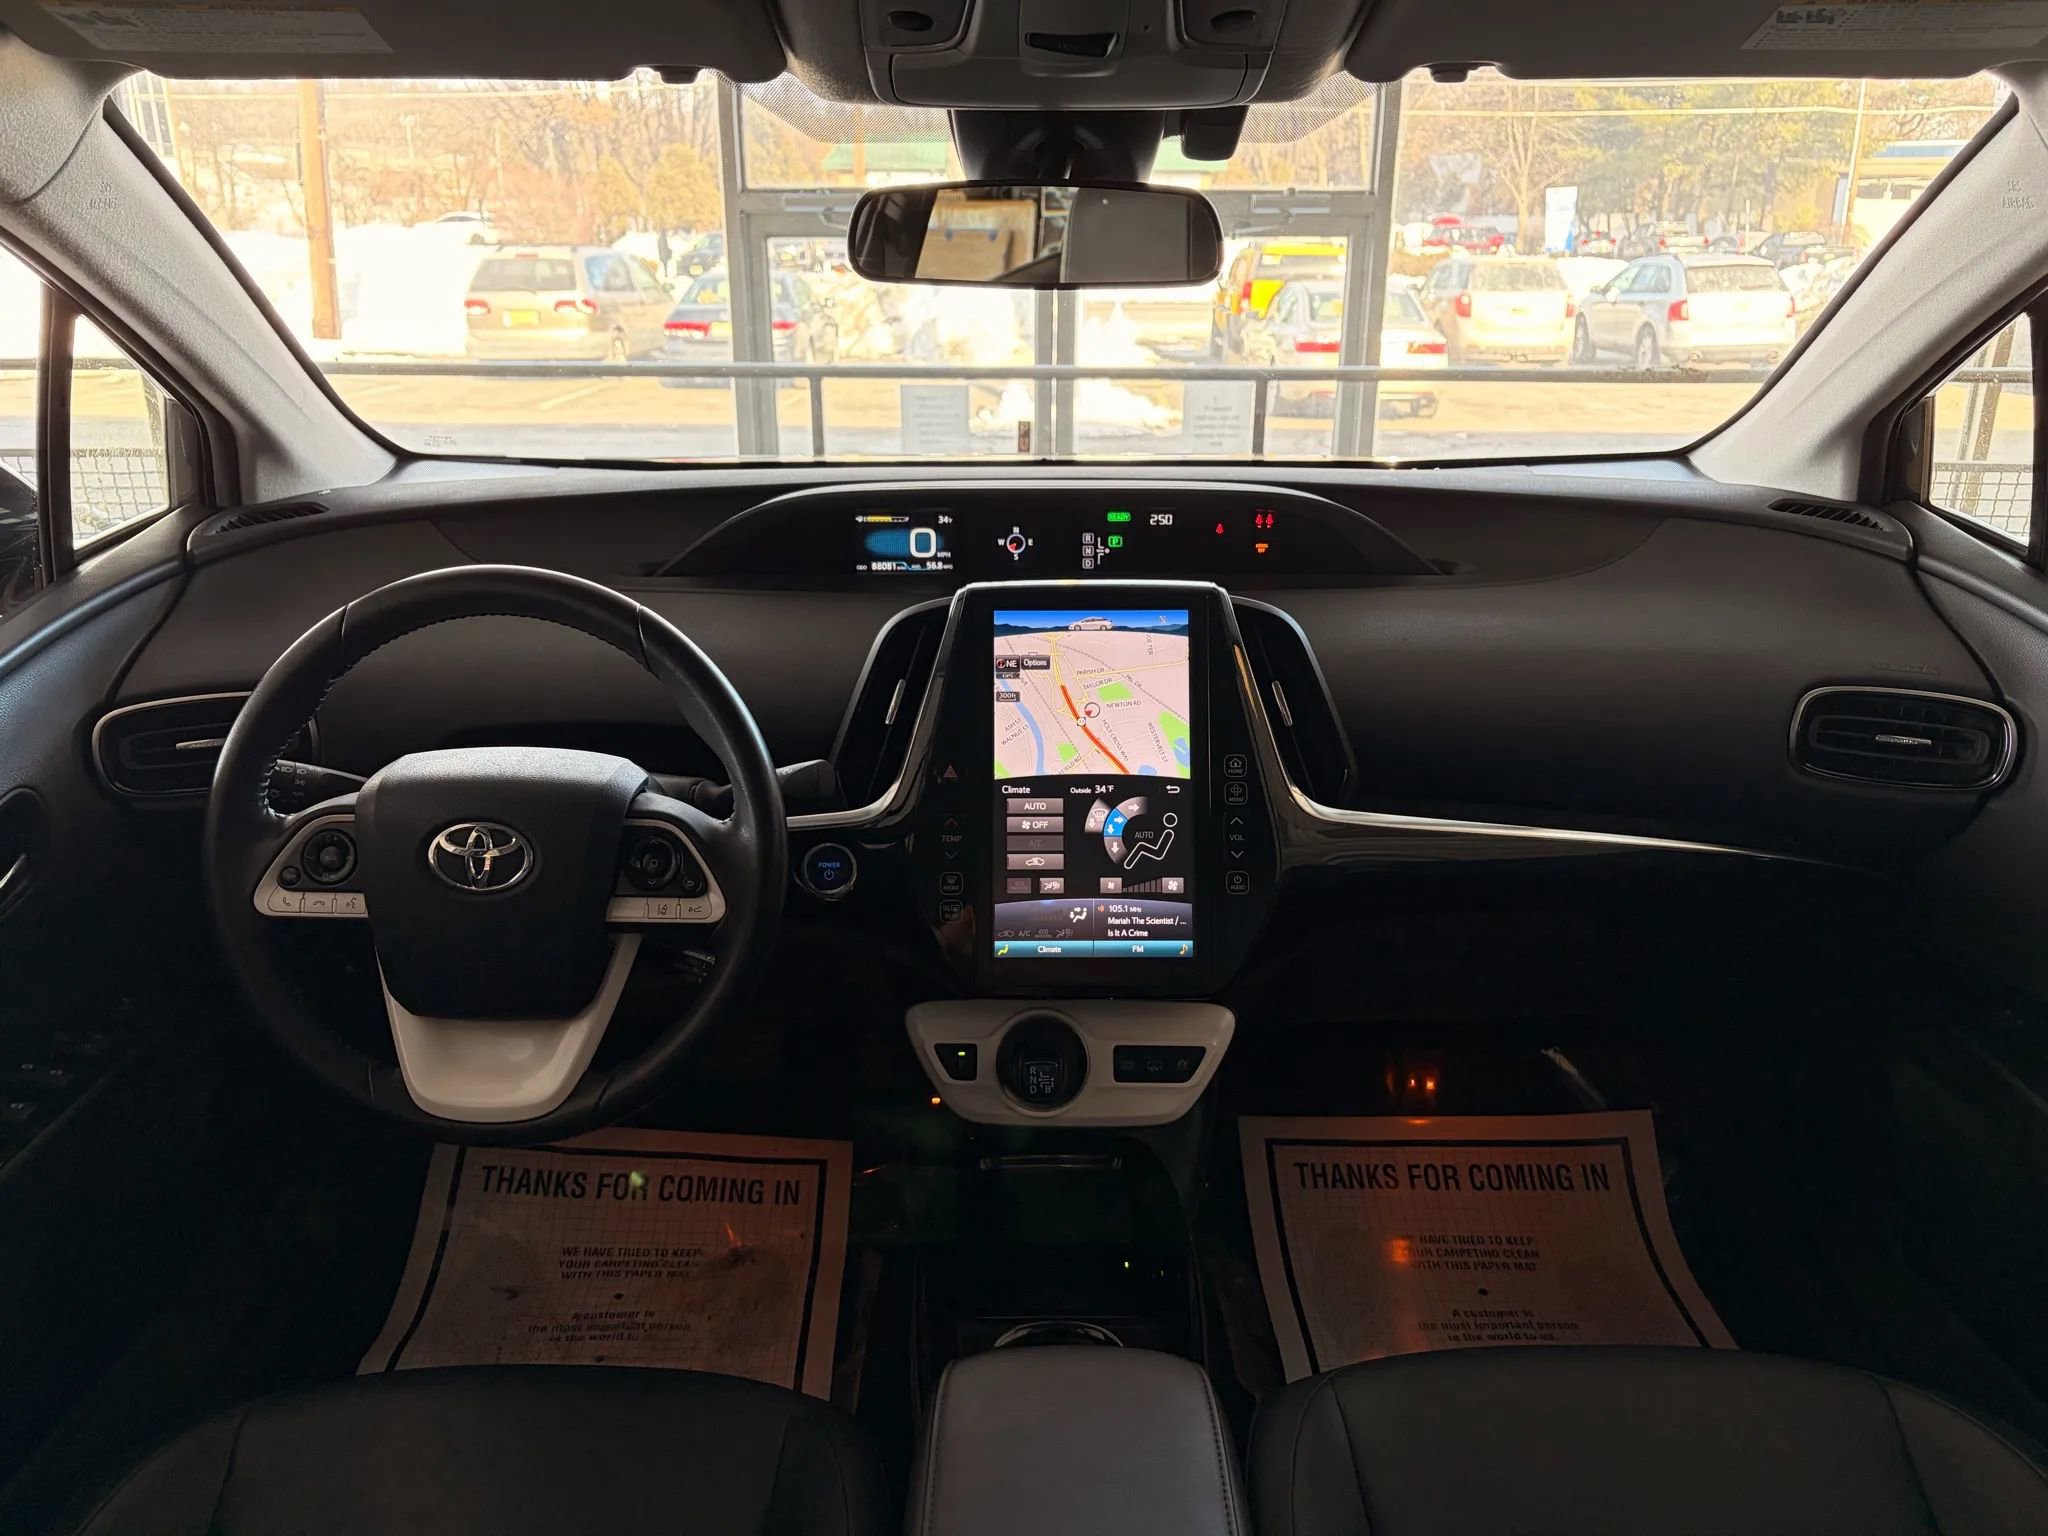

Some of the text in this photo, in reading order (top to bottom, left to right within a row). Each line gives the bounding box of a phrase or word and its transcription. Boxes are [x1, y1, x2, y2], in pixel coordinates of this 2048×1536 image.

[1108, 513, 1129, 521] READY
[1150, 514, 1173, 525] 250
[1012, 526, 1019, 534] N
[909, 527, 937, 558] 0
[998, 538, 1005, 546] W
[1028, 538, 1033, 546] E
[1085, 534, 1092, 543] R
[1112, 537, 1119, 546] P
[1085, 547, 1092, 555] N
[1085, 559, 1092, 567] D
[1006, 659, 1018, 668] NE
[1023, 658, 1047, 667] Options
[1001, 729, 1022, 745] WALNUT
[1110, 733, 1123, 752] CROSS
[1002, 785, 1031, 794] Climate
[1070, 786, 1091, 794] Outside
[1094, 785, 1106, 793] 34
[1024, 802, 1046, 810] AUTO
[1032, 821, 1048, 829] OFF
[1134, 831, 1154, 839] AUTO
[1229, 833, 1245, 841] VOL
[1029, 839, 1042, 848] A/C
[1108, 905, 1128, 913] 105.1
[1108, 916, 1131, 925] Mariah
[1132, 916, 1145, 925] The
[1145, 916, 1174, 925] Scientist
[1018, 929, 1031, 938] A/C
[1108, 929, 1148, 937] Is It A Crime
[1037, 945, 1062, 953] Climate
[1132, 945, 1144, 953] FM
[1030, 1066, 1036, 1075] R
[1030, 1076, 1037, 1084] N
[1030, 1085, 1037, 1094] D
[1045, 1085, 1051, 1094] B
[1294, 1162, 1610, 1191] THANKS FOR COMING IN
[481, 1165, 800, 1206] THANKS FOR COMING IN
[1420, 1235, 1449, 1246] HAVE
[1452, 1235, 1485, 1246] TRIED
[1487, 1235, 1502, 1246] TO
[1505, 1236, 1534, 1246] KEEP
[561, 1246, 701, 1258] WE HAVE TRIED TO KEEP
[1436, 1249, 1500, 1260] CARPETING
[1503, 1249, 1540, 1260] CLEAN
[558, 1259, 590, 1269] YOUR
[1410, 1260, 1537, 1272] WITH THIS PAPER MAT
[560, 1270, 591, 1280] WITH
[595, 1270, 623, 1279] THIS
[624, 1270, 663, 1279] PAPER
[583, 1310, 640, 1320] customer
[1452, 1309, 1461, 1319] A
[1463, 1309, 1519, 1319] customer
[527, 1323, 547, 1333] the
[551, 1322, 582, 1332] most
[1441, 1321, 1471, 1331] most
[1474, 1320, 1533, 1332] important
[1535, 1321, 1579, 1332] person
[565, 1332, 585, 1342] the
[588, 1332, 624, 1342] world
[1461, 1332, 1481, 1342] the
[1486, 1332, 1522, 1342] world
